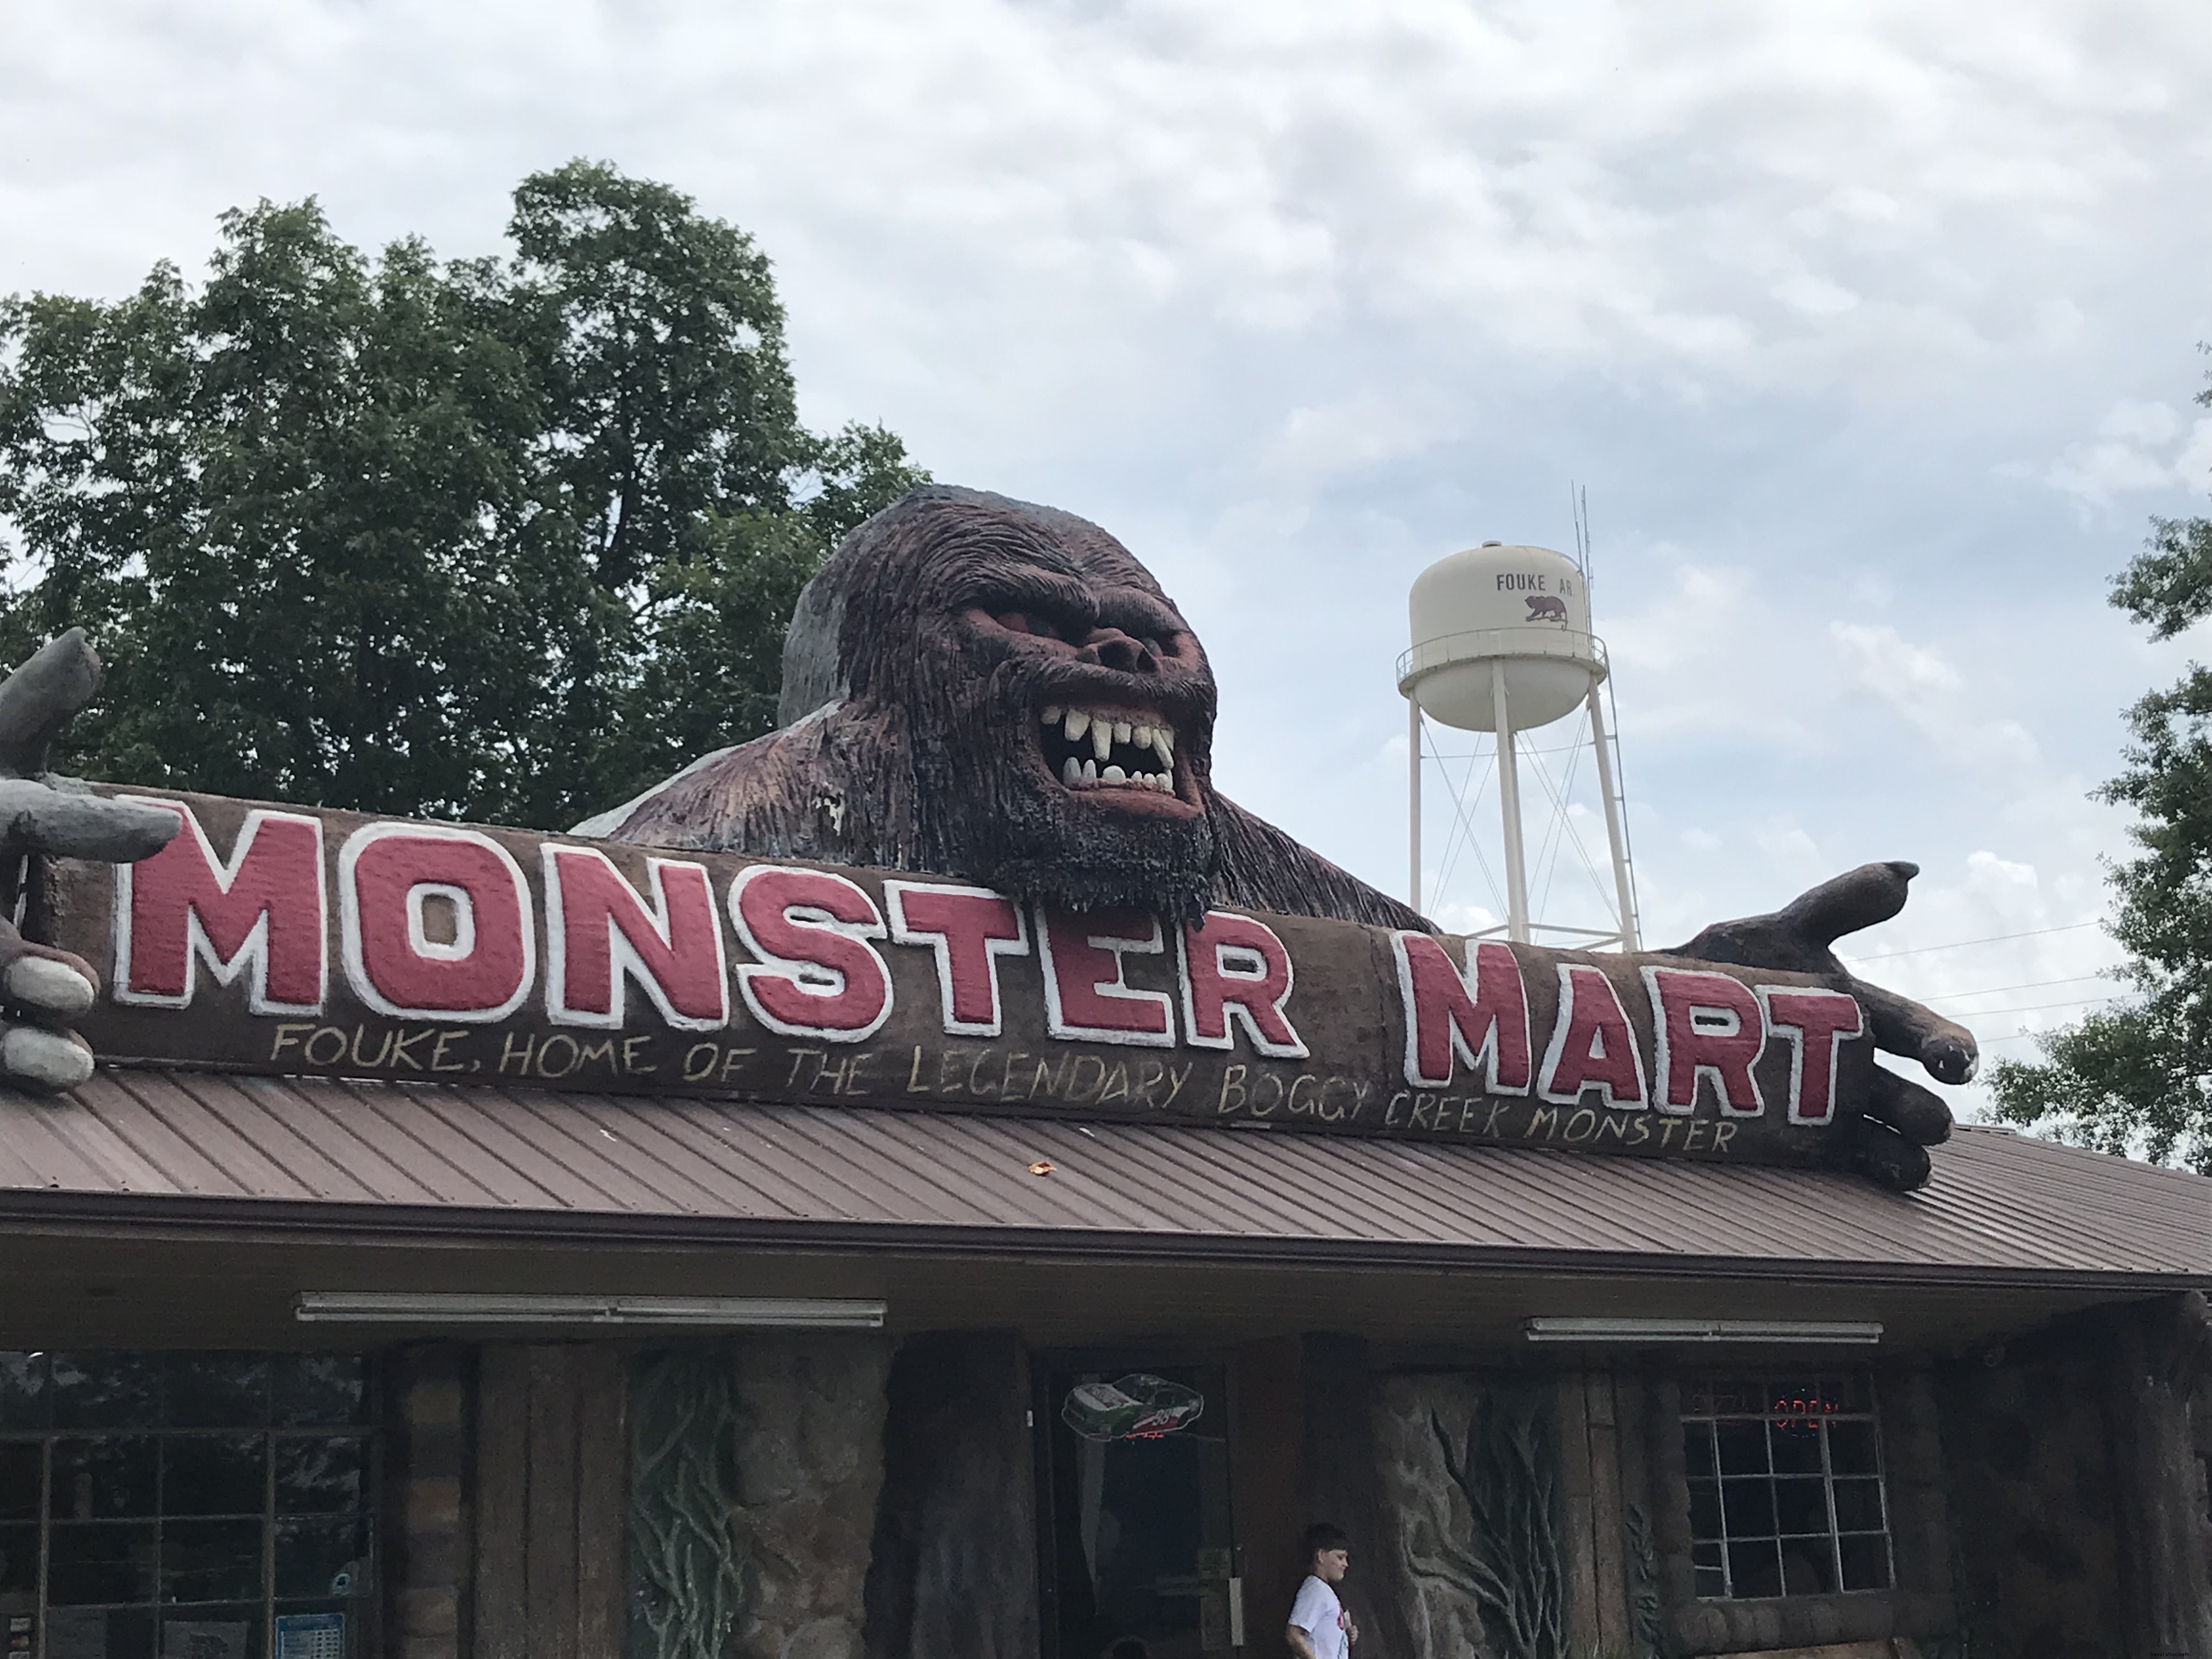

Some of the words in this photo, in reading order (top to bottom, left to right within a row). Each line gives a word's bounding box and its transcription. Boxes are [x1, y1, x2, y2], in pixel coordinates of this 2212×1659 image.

[1497, 573, 1546, 591] FOUKE
[114, 794, 1310, 1059] MONSTER
[1389, 929, 1864, 1126] MART
[269, 1022, 481, 1073] FOUKE,
[498, 1031, 657, 1077] HOME
[682, 1042, 757, 1083] OF
[786, 1048, 874, 1095] THE
[906, 1045, 1193, 1109] LEGENDARY
[1217, 1064, 1370, 1121] BOGGY
[1384, 1090, 1510, 1139] CREEK
[1523, 1107, 1739, 1153] MONSTER
